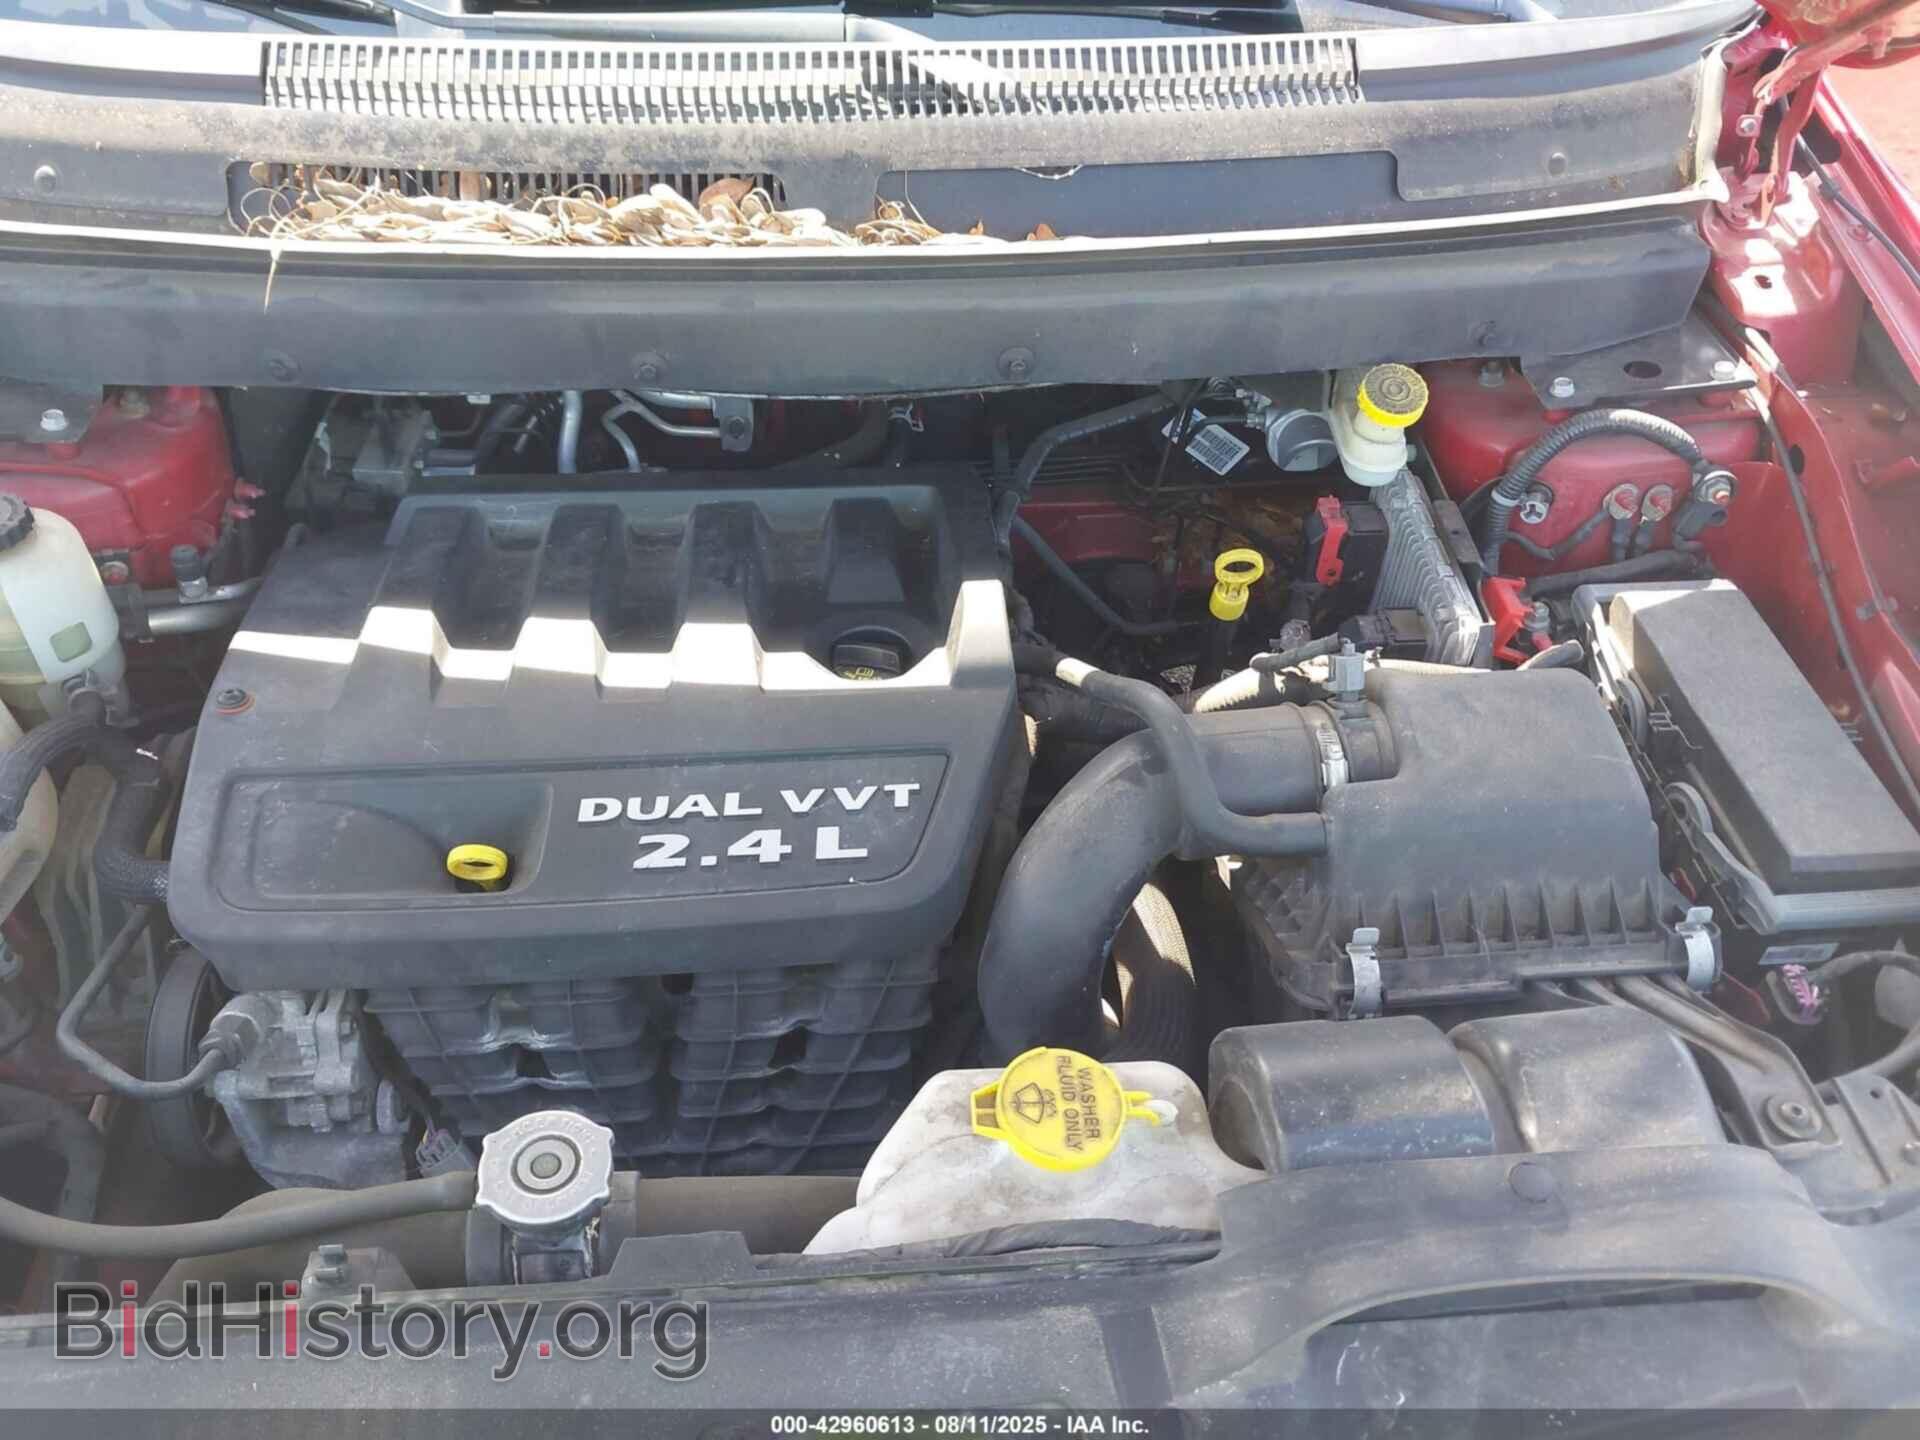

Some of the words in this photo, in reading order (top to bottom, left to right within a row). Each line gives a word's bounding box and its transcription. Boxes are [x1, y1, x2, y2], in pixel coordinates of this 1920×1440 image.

[577, 792, 763, 823] DUAL
[780, 783, 921, 813] VVT
[1057, 1056, 1077, 1102] FLUID
[1077, 1067, 1101, 1139] WASHER
[1064, 1108, 1083, 1151] ONLY
